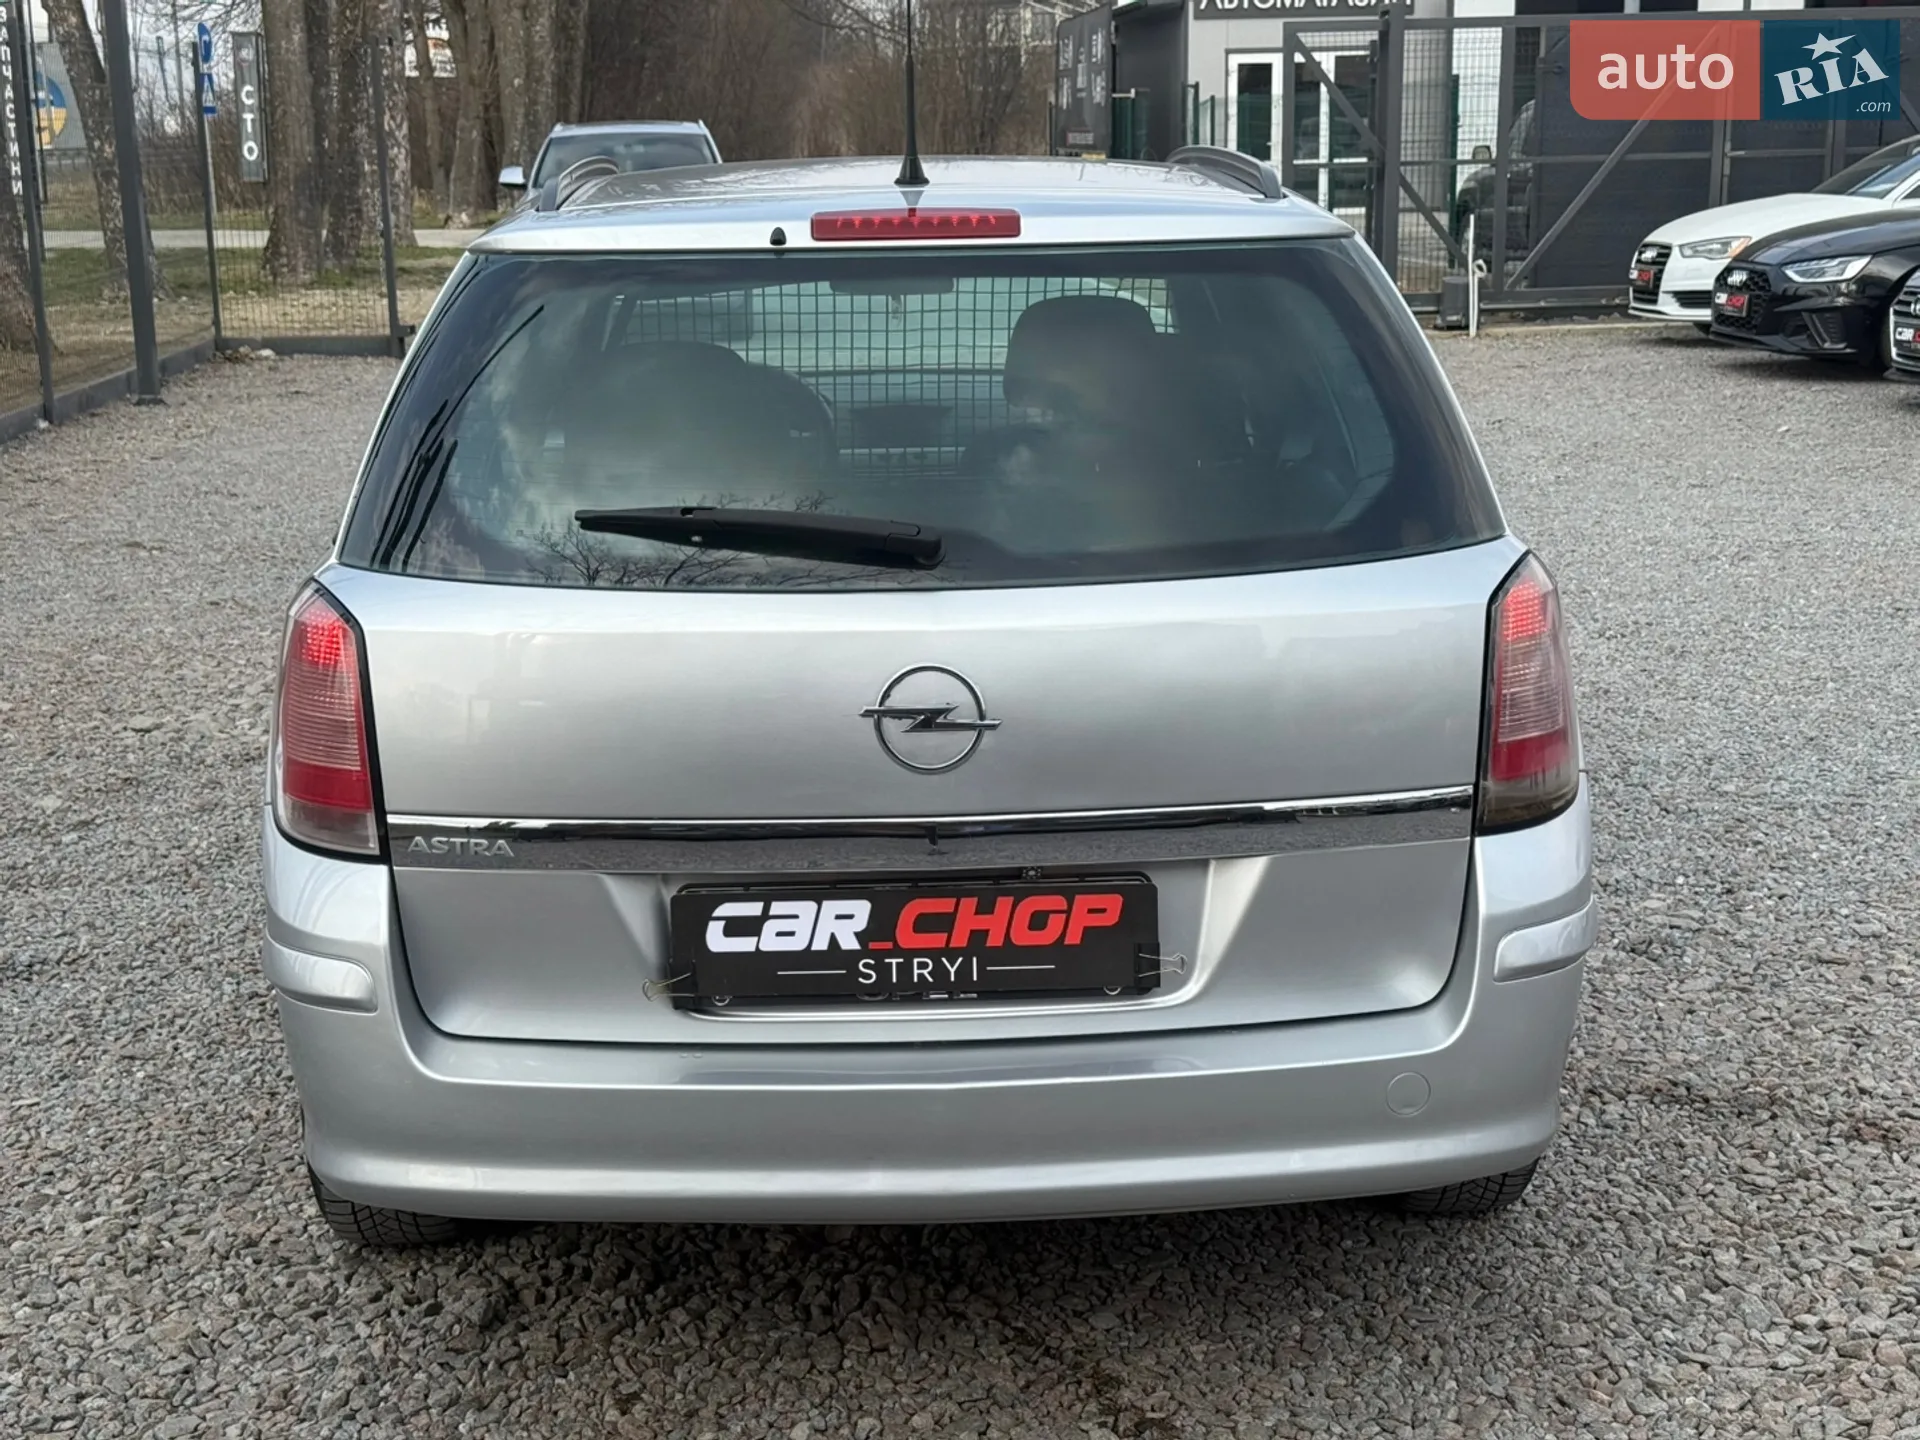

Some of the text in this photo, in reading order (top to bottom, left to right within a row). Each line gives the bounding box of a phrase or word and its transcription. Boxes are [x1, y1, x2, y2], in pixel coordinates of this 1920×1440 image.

[240, 84, 259, 161] СТО
[407, 835, 515, 857] ASTRA
[857, 955, 979, 984] STRYI
